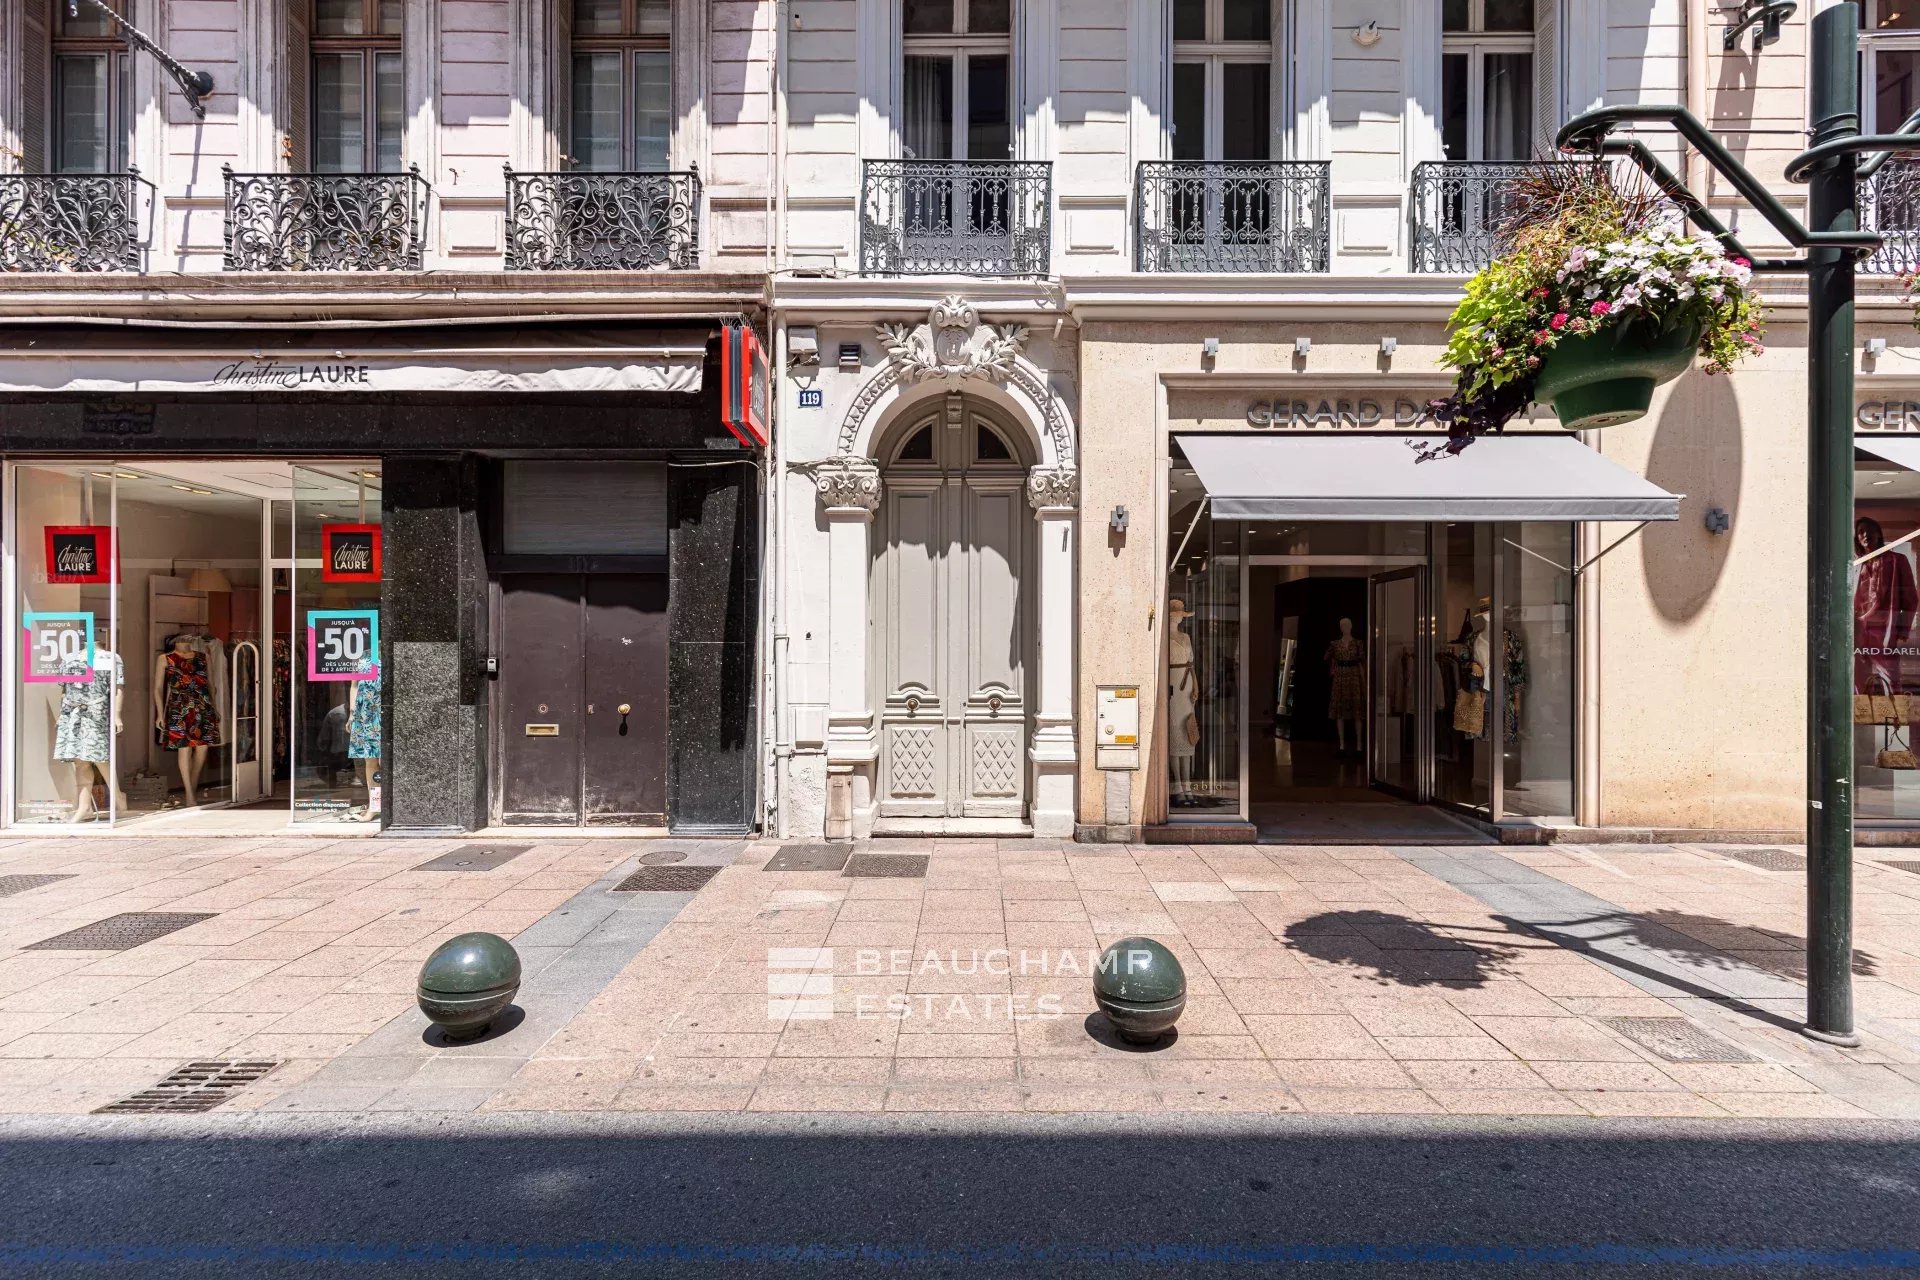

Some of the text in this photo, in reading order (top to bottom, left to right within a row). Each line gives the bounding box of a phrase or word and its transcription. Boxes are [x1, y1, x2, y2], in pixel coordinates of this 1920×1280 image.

[214, 361, 369, 388] Christine LAURE
[801, 393, 820, 405] 119
[1246, 400, 1383, 425] GERARD
[58, 544, 95, 565] Christine
[334, 542, 370, 563] Christine
[59, 562, 91, 571] LAURE
[335, 561, 367, 570] LAURE
